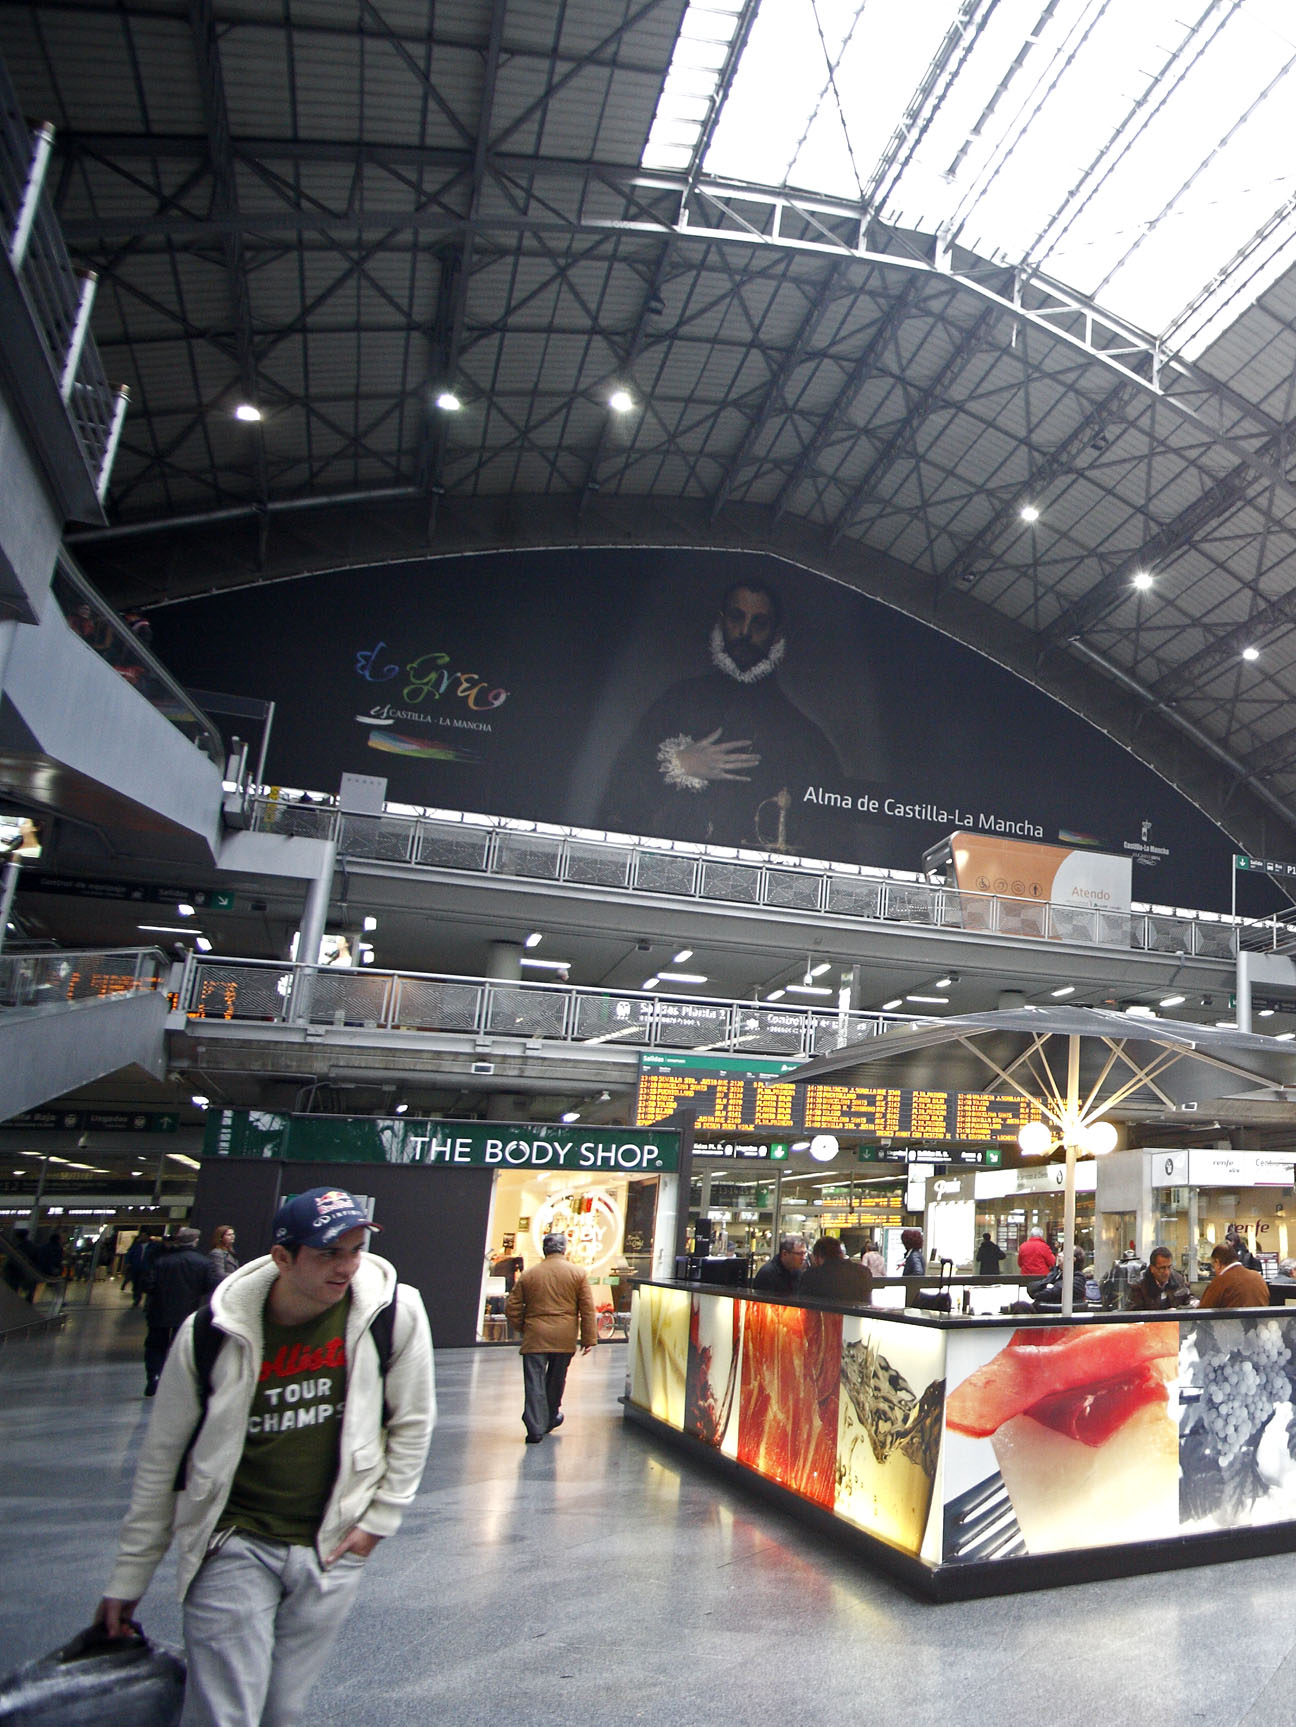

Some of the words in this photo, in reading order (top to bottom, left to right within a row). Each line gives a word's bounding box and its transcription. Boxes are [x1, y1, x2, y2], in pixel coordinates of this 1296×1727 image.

[389, 709, 432, 723] CASTILLA
[439, 717, 452, 726] LA
[453, 719, 492, 732] MANCHA
[803, 786, 852, 808] Alma
[857, 795, 879, 812] de
[884, 799, 974, 827] Castilla-La
[978, 813, 1044, 838] Mancha
[1150, 845, 1170, 855] Mancha
[1287, 865, 1296, 875] P1
[1072, 886, 1111, 901] Atendo
[410, 1136, 473, 1163] THE
[484, 1139, 574, 1165] BODY
[1213, 1160, 1234, 1168] renfe
[1226, 1218, 1270, 1234] renfe
[264, 1377, 332, 1406] TOUR
